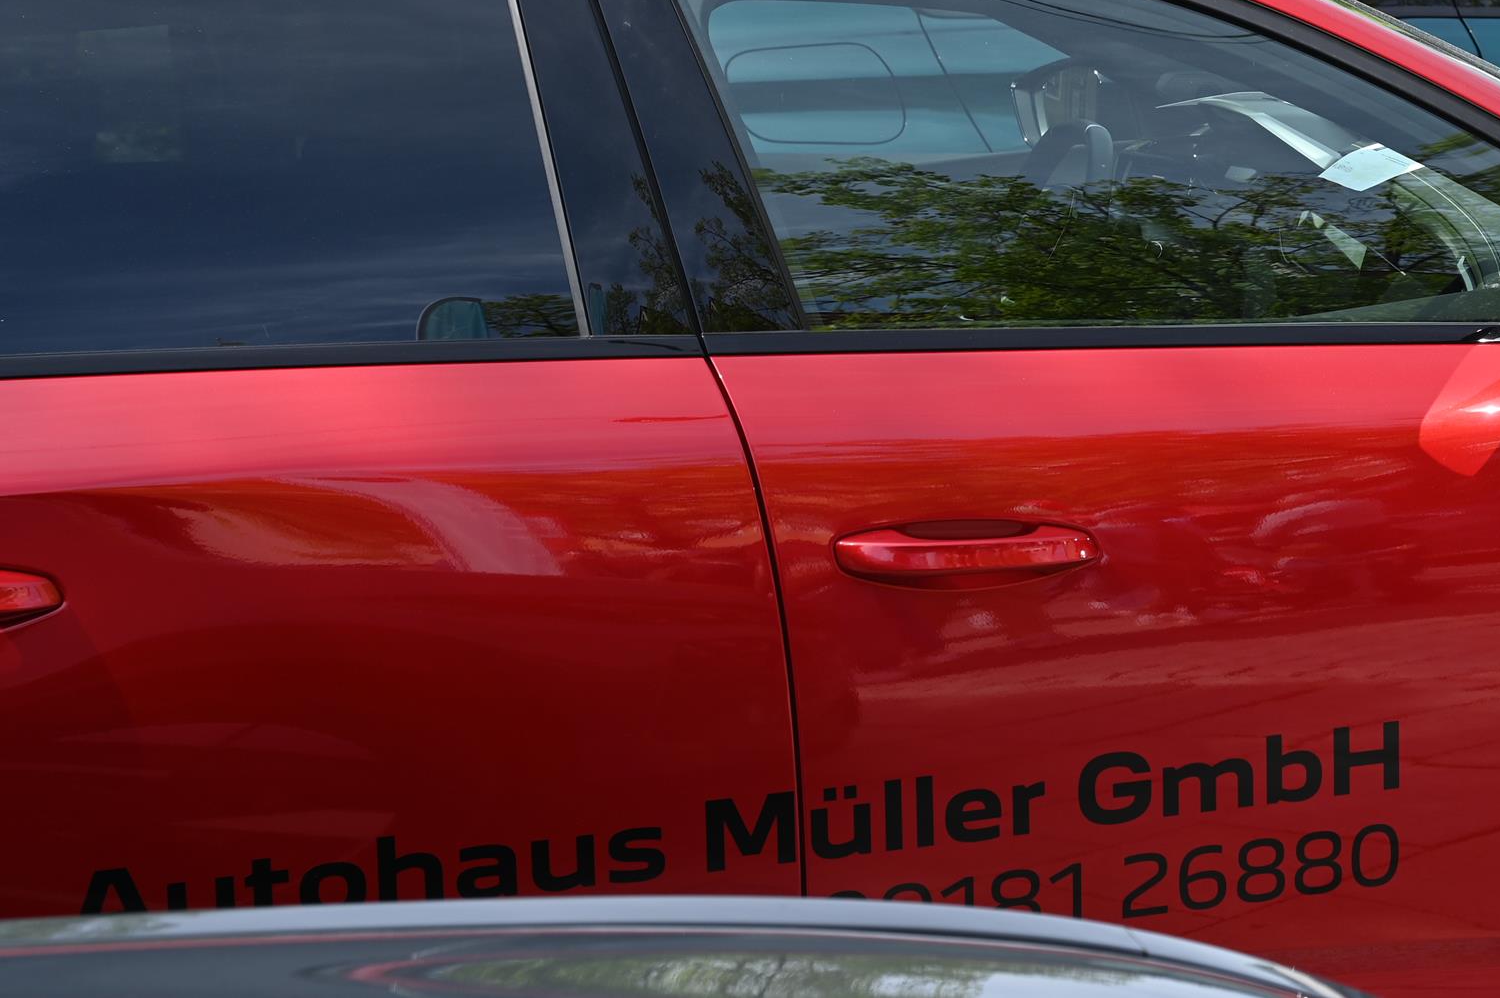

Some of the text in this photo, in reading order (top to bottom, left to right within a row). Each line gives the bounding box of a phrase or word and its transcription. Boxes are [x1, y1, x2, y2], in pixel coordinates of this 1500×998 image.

[704, 775, 1046, 873] Müller
[1077, 720, 1401, 827] GmbH
[1122, 823, 1401, 920] 26880
